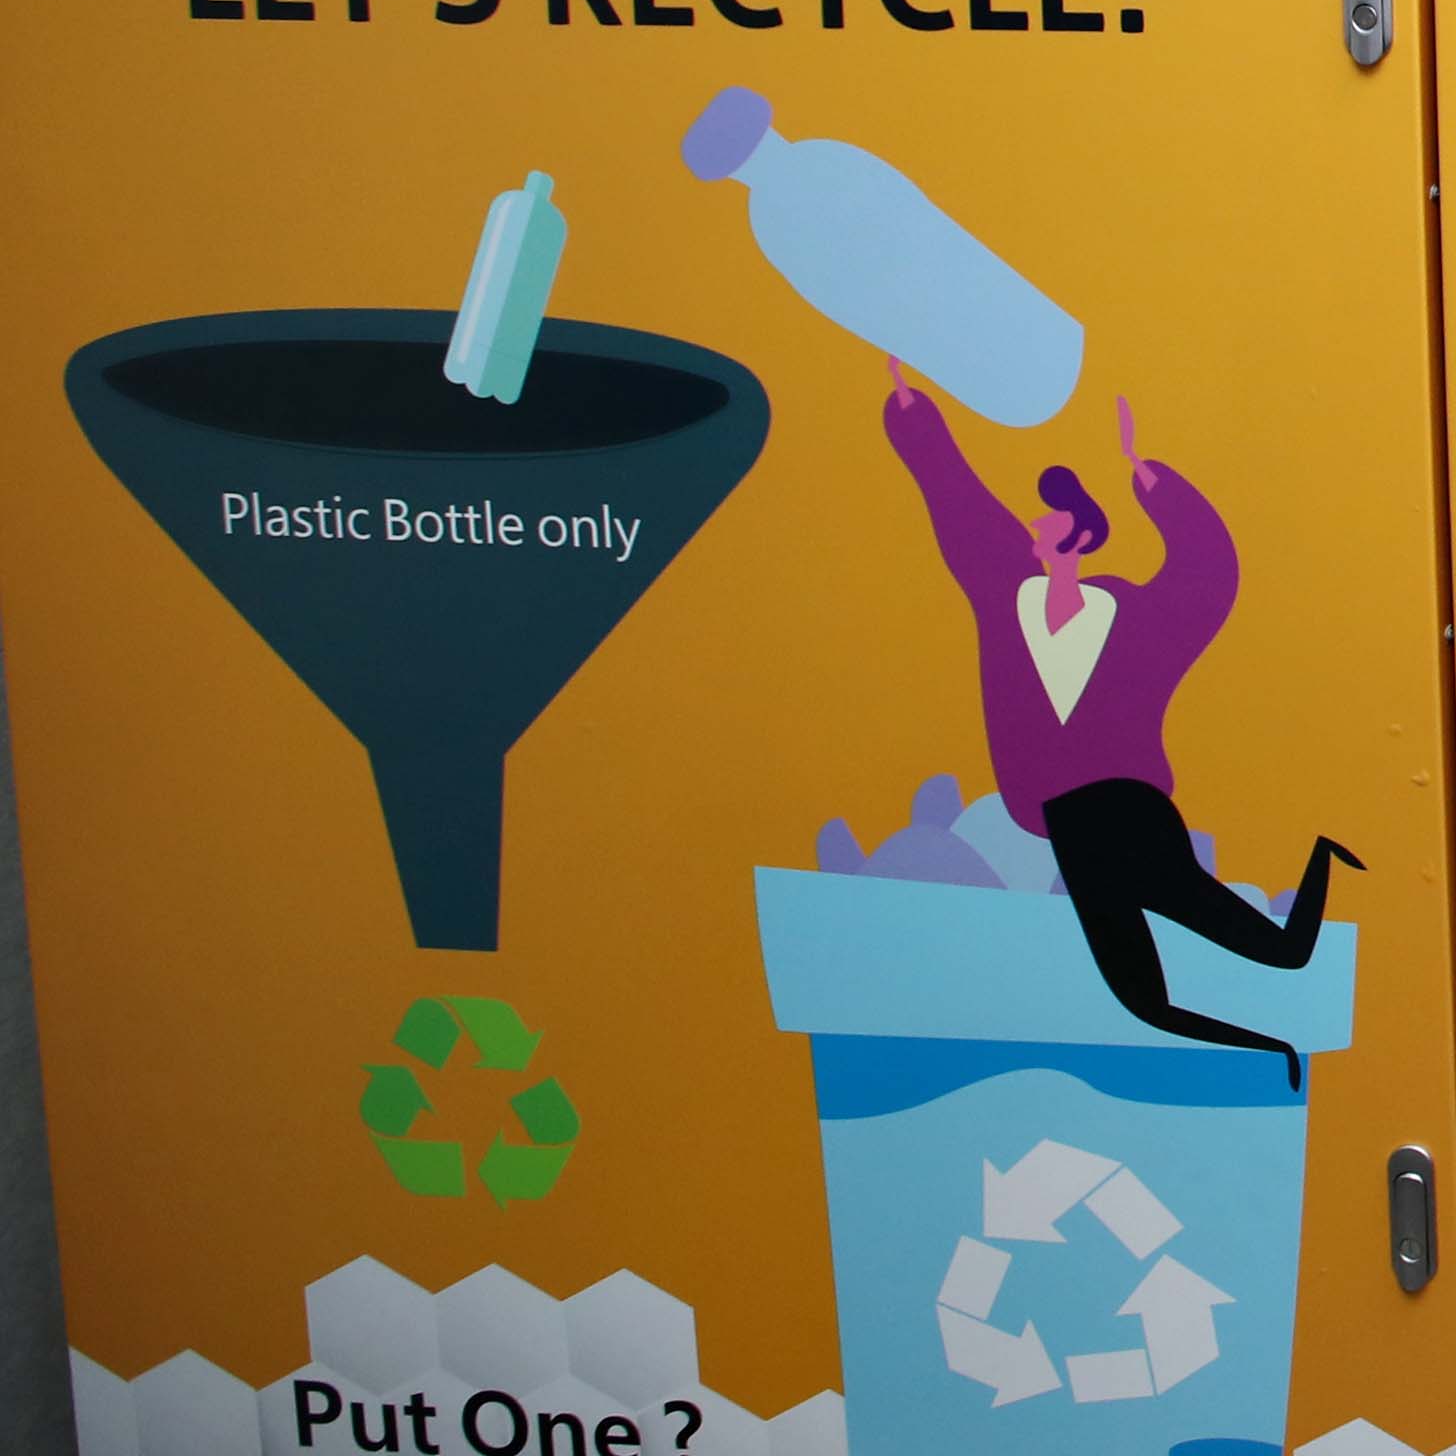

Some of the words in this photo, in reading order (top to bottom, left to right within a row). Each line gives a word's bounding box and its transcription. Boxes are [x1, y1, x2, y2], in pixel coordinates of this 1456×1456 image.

[222, 492, 370, 541] Plastic
[383, 499, 525, 547] Bottle
[537, 503, 641, 562] only
[293, 1379, 440, 1455] Put
[462, 1389, 641, 1456] One
